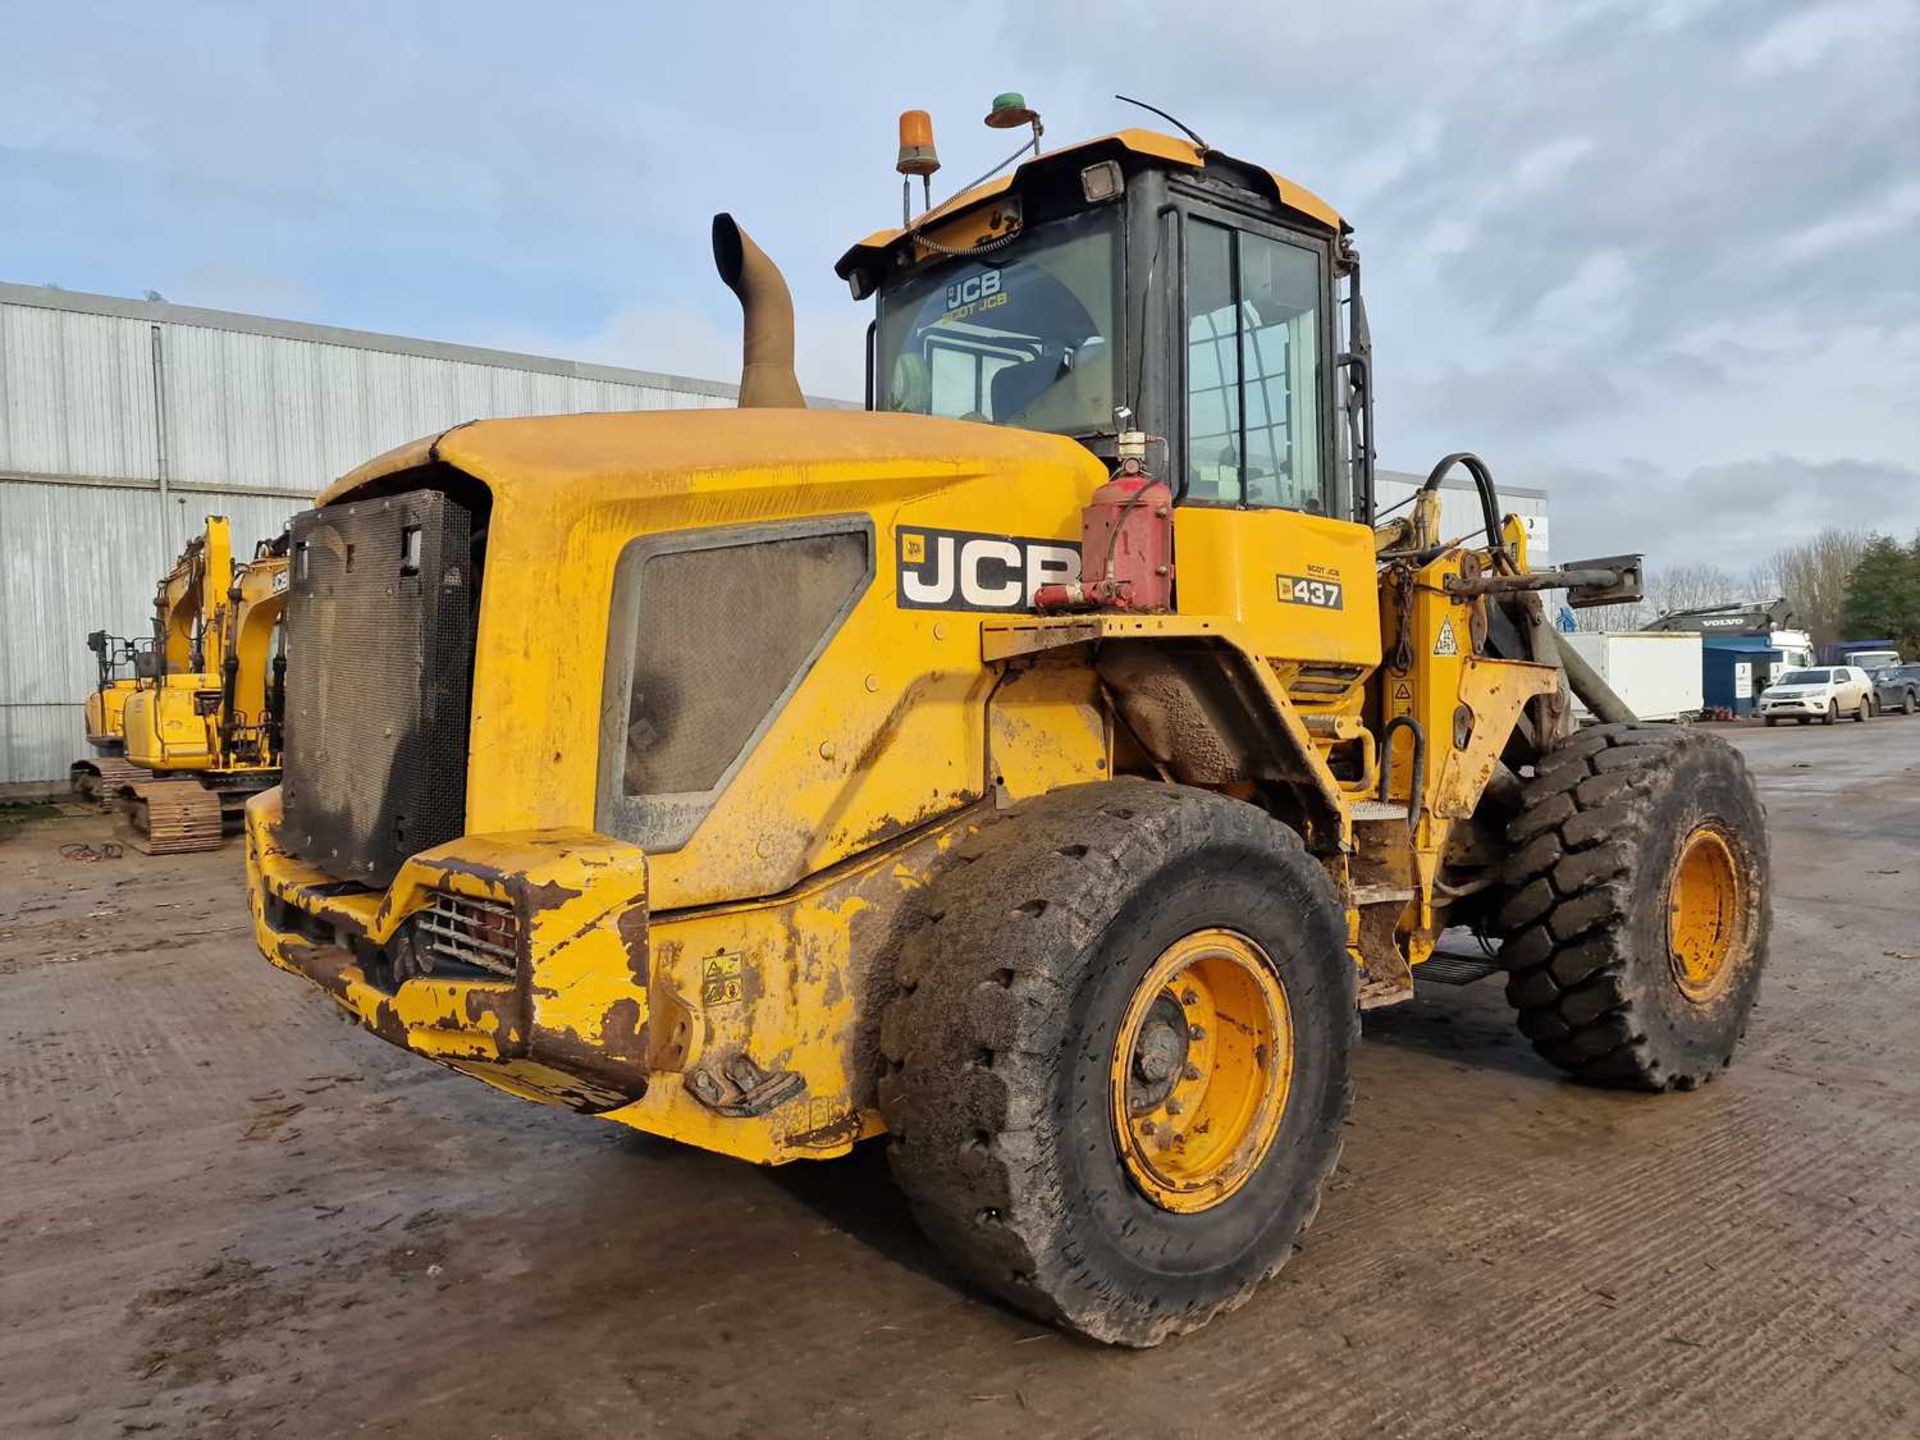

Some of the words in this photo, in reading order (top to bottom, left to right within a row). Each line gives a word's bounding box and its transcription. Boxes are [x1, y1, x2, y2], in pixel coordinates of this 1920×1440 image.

[947, 269, 1001, 310] JCB
[979, 292, 1007, 312] JCB
[902, 536, 1083, 607] JCB
[1293, 580, 1339, 606] 437
[1701, 618, 1744, 627] VOLVO
